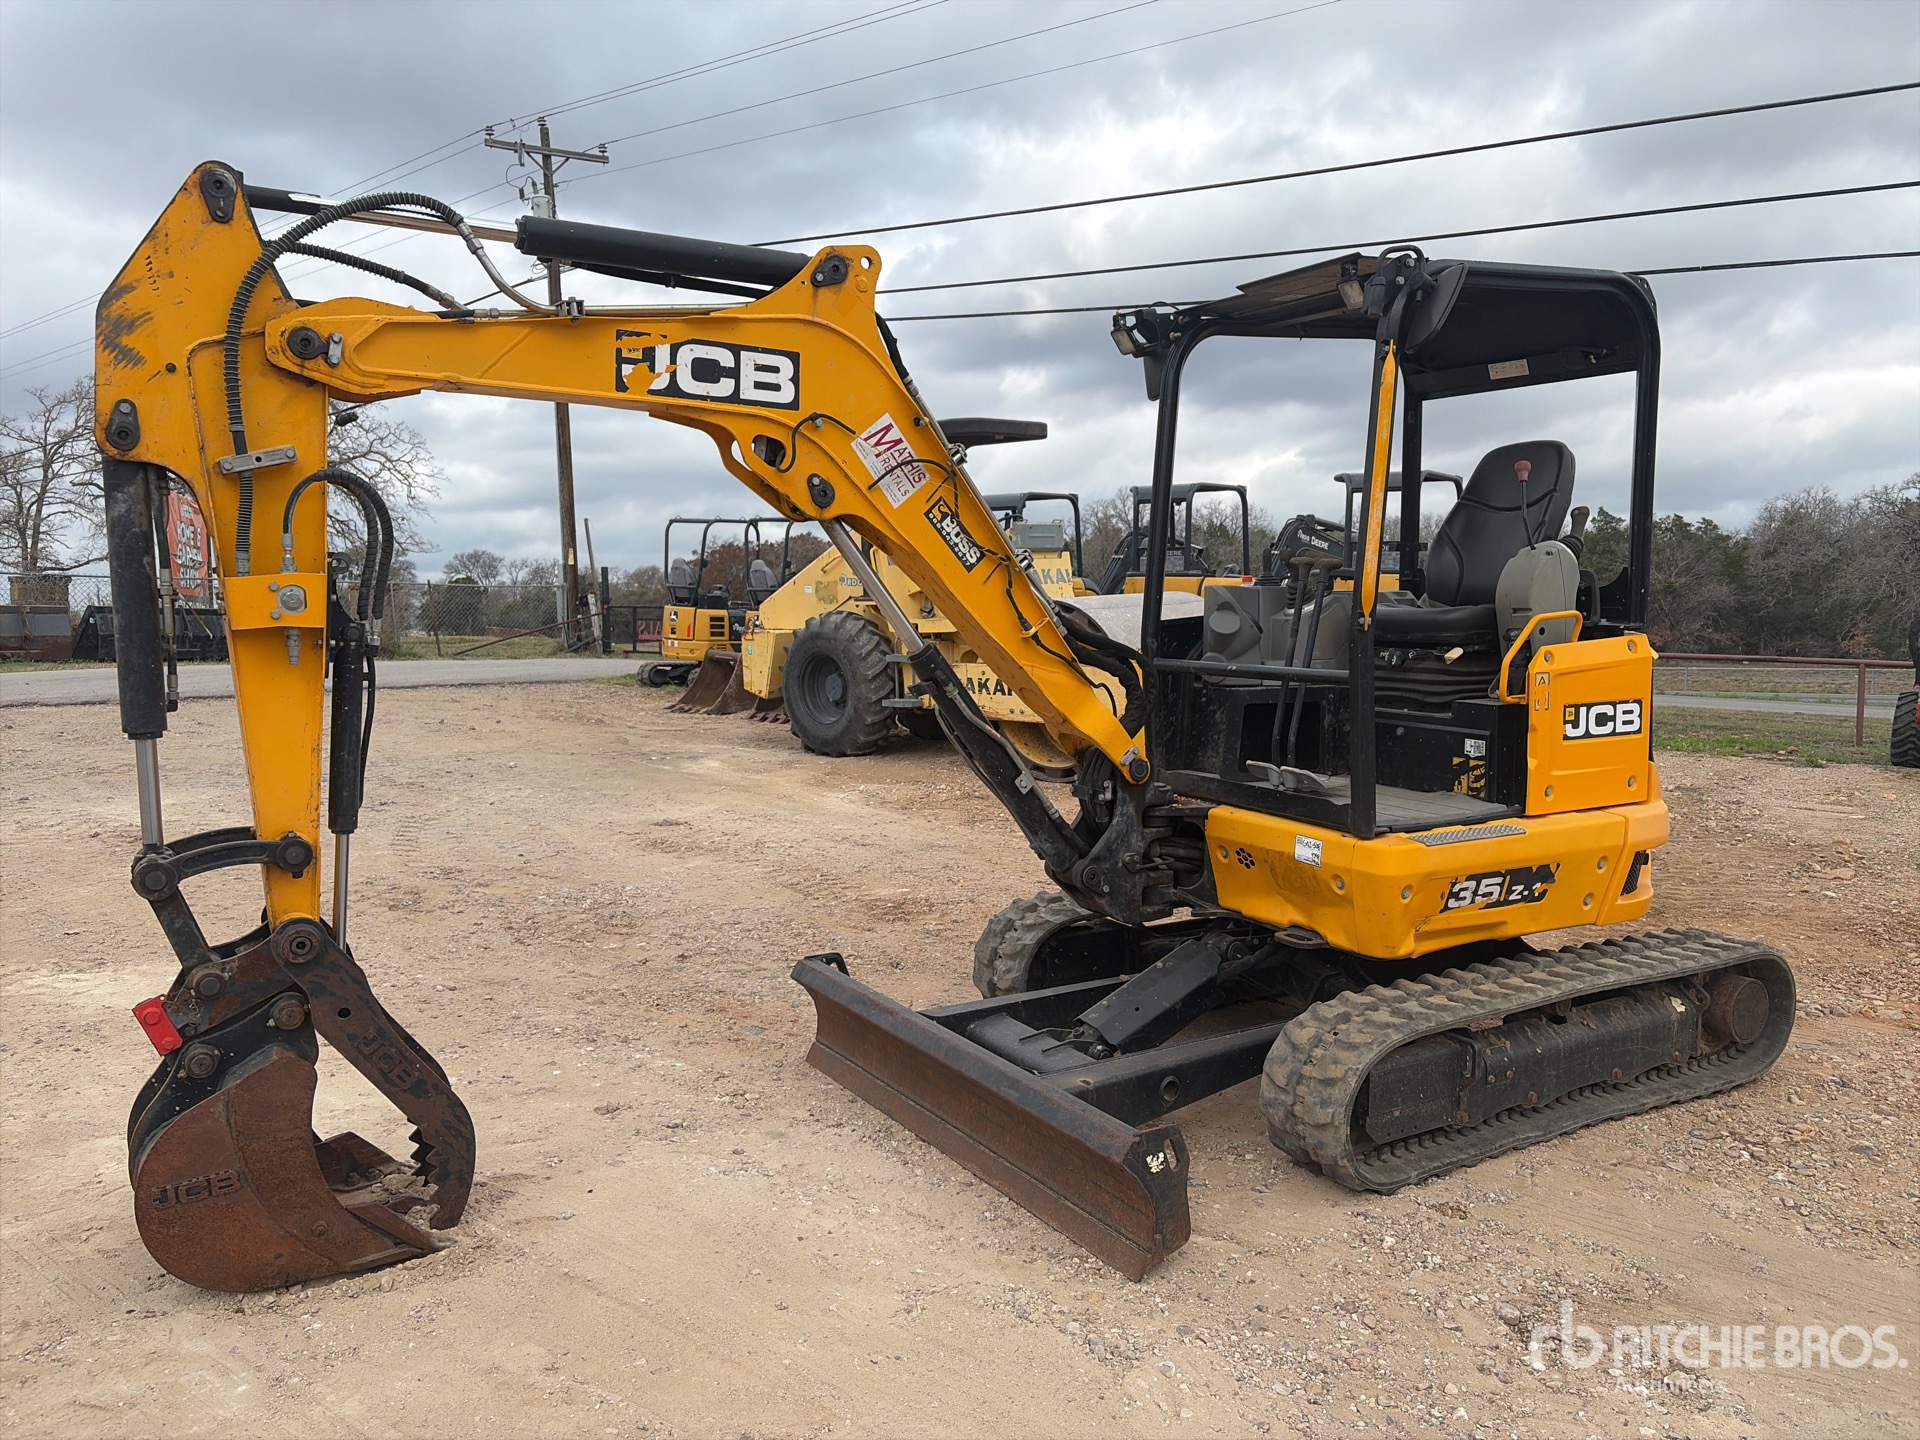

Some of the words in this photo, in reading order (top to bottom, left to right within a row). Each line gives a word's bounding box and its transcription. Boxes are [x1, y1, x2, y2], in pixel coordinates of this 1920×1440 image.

[621, 343, 796, 404] JCB
[863, 422, 928, 485] MATHIS
[880, 456, 910, 497] RENTALS
[941, 515, 981, 564] BOSS
[1311, 536, 1329, 550] DEERE
[1033, 568, 1072, 584] AKAI
[966, 677, 1013, 697] AKAI
[1565, 703, 1641, 738] JCB
[1447, 876, 1504, 908] 35
[152, 1169, 241, 1207] JCB
